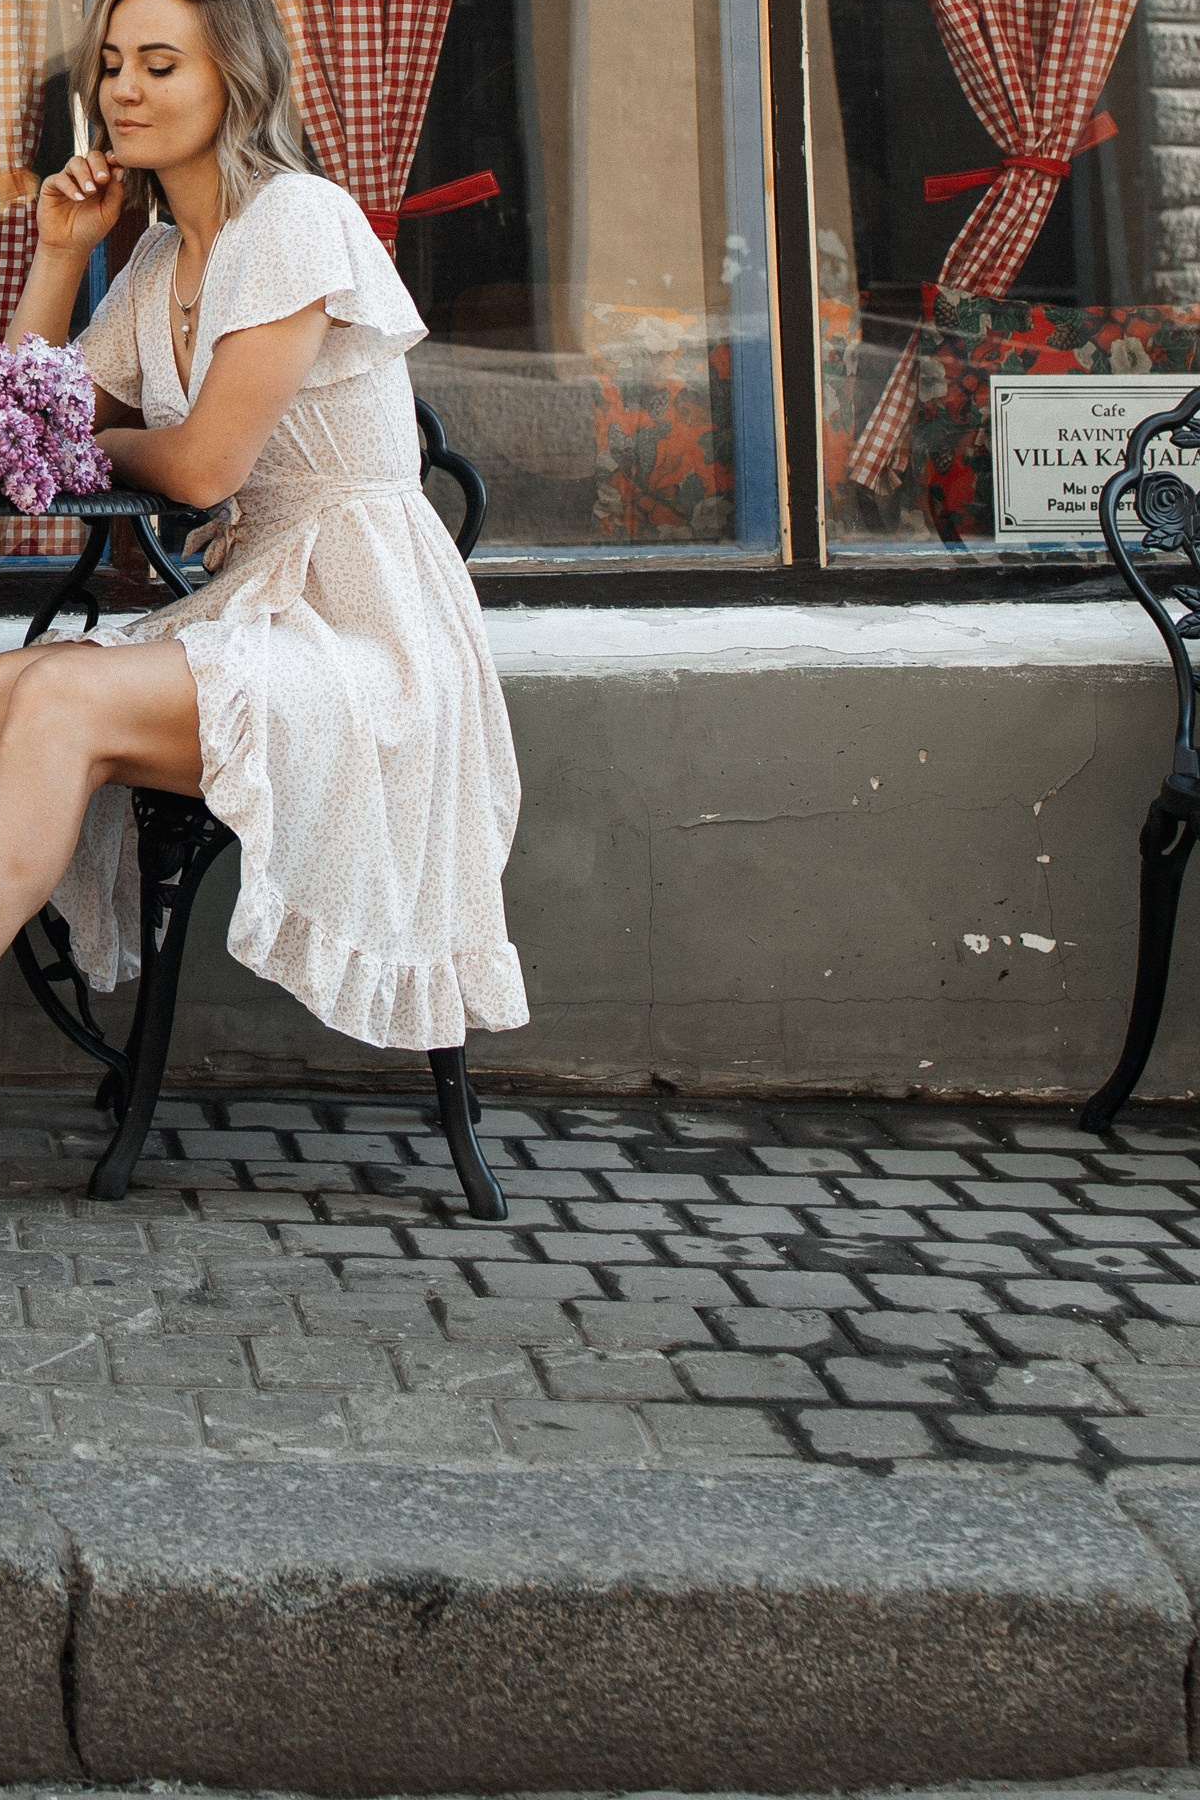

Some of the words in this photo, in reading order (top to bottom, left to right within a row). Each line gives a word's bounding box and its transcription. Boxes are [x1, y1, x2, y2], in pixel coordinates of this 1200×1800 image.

[1091, 403, 1126, 417] Cafe
[1013, 448, 1088, 467] VILLA
[1095, 448, 1200, 472] KAJALA
[1063, 481, 1087, 495] Мы
[1047, 498, 1086, 514] Рады
